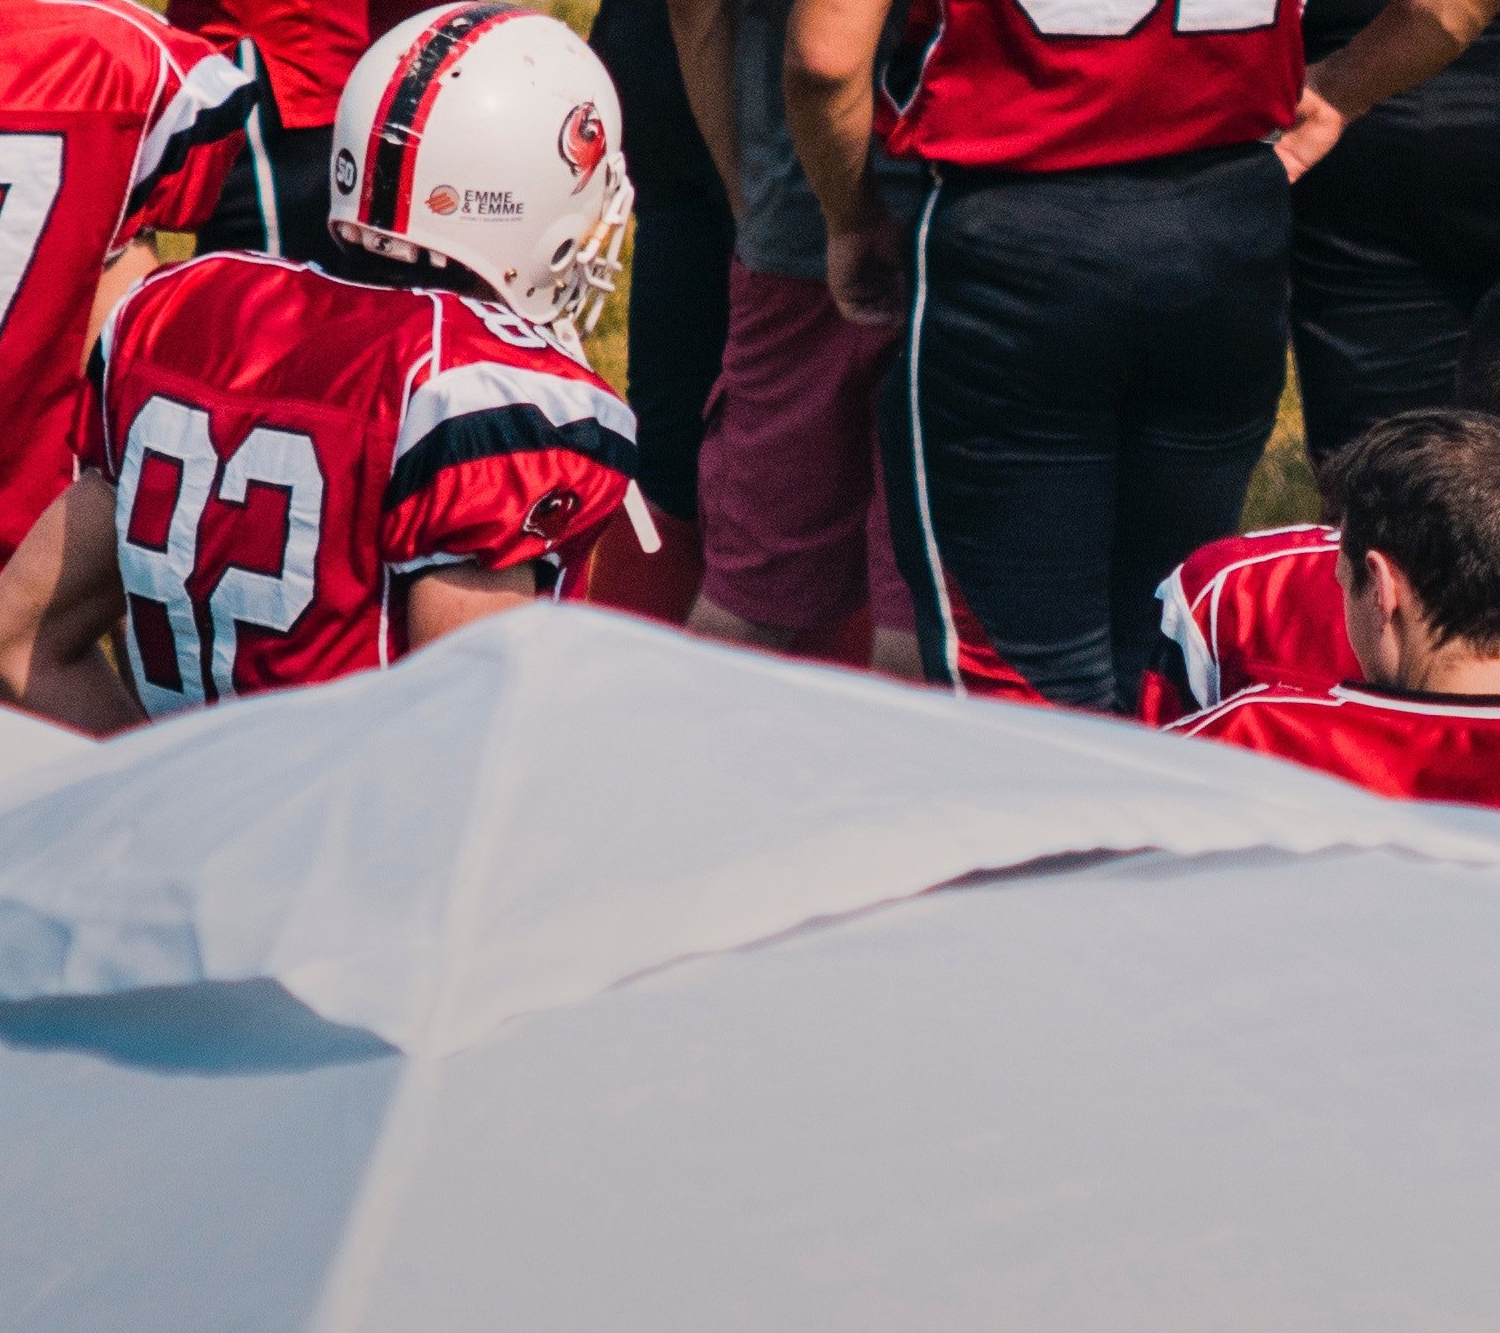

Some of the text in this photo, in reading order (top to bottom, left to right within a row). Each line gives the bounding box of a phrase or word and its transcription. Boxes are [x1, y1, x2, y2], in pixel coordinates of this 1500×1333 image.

[464, 189, 512, 204] EMME
[461, 201, 525, 215] & EMME
[115, 393, 324, 723] 82
